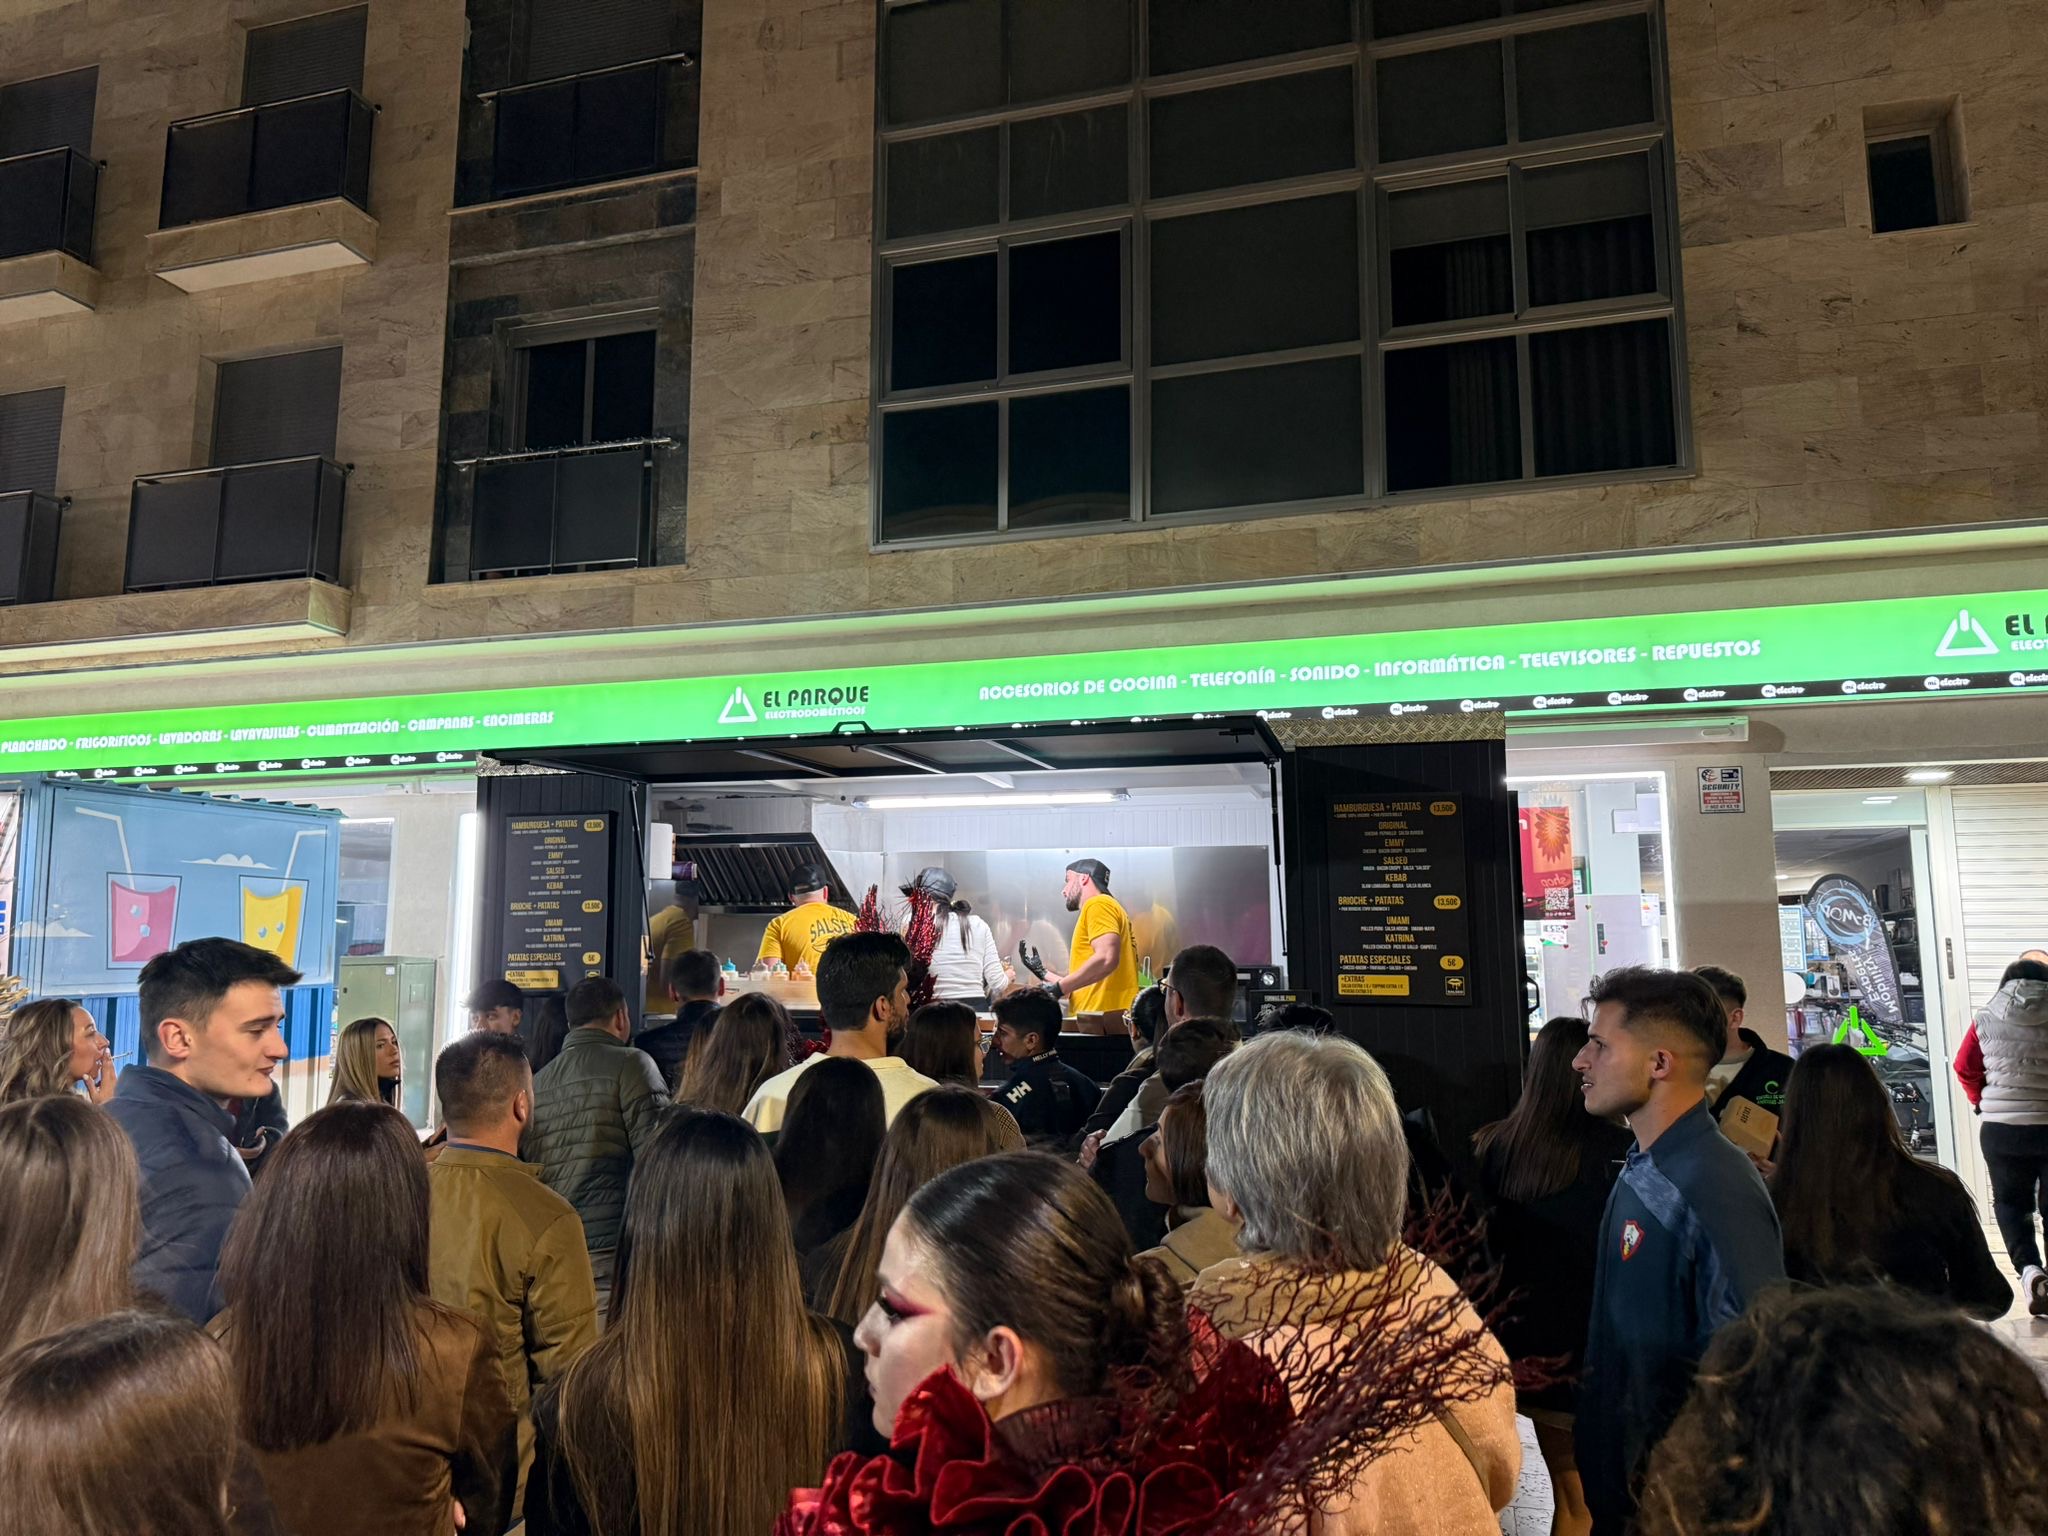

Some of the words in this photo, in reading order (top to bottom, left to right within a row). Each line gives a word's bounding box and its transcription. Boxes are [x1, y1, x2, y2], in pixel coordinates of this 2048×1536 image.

[2005, 614, 2035, 636] EL
[979, 680, 1080, 701] ACCESORIOS
[1083, 679, 1105, 694] DE
[1109, 674, 1178, 693] COCINA
[1190, 666, 1276, 688] TELEFONÍA
[1289, 663, 1361, 682] SONIDO
[1374, 654, 1505, 677] INFORMÁTICA
[1519, 646, 1637, 669] TELEVISORES
[1652, 639, 1761, 661] REPUESTOS
[763, 690, 781, 708] EL
[787, 685, 869, 707] PARQUE
[1, 738, 67, 753] PLANCHADO
[159, 729, 222, 745] LAVADORAS
[230, 725, 300, 742] LAVAVAJILLAS
[306, 719, 400, 738] CLIMATIZACIÓN
[408, 715, 474, 732] CAMPANAS
[482, 711, 554, 728] ENCIMERAS
[1702, 783, 1740, 791] SECURITY
[1391, 801, 1422, 811] PATATAS
[555, 819, 578, 828] PATATAS
[1383, 856, 1408, 865] SALSEO
[1384, 873, 1408, 882] KEBAB
[1375, 895, 1405, 905] PATATAS
[537, 901, 560, 910] PATATAS
[1385, 933, 1415, 943] KATRINA
[507, 953, 529, 962] PATATAS
[530, 952, 562, 961] ESPECIALES
[1339, 955, 1369, 964] PATATAS
[1369, 954, 1411, 964] ESPECIALES
